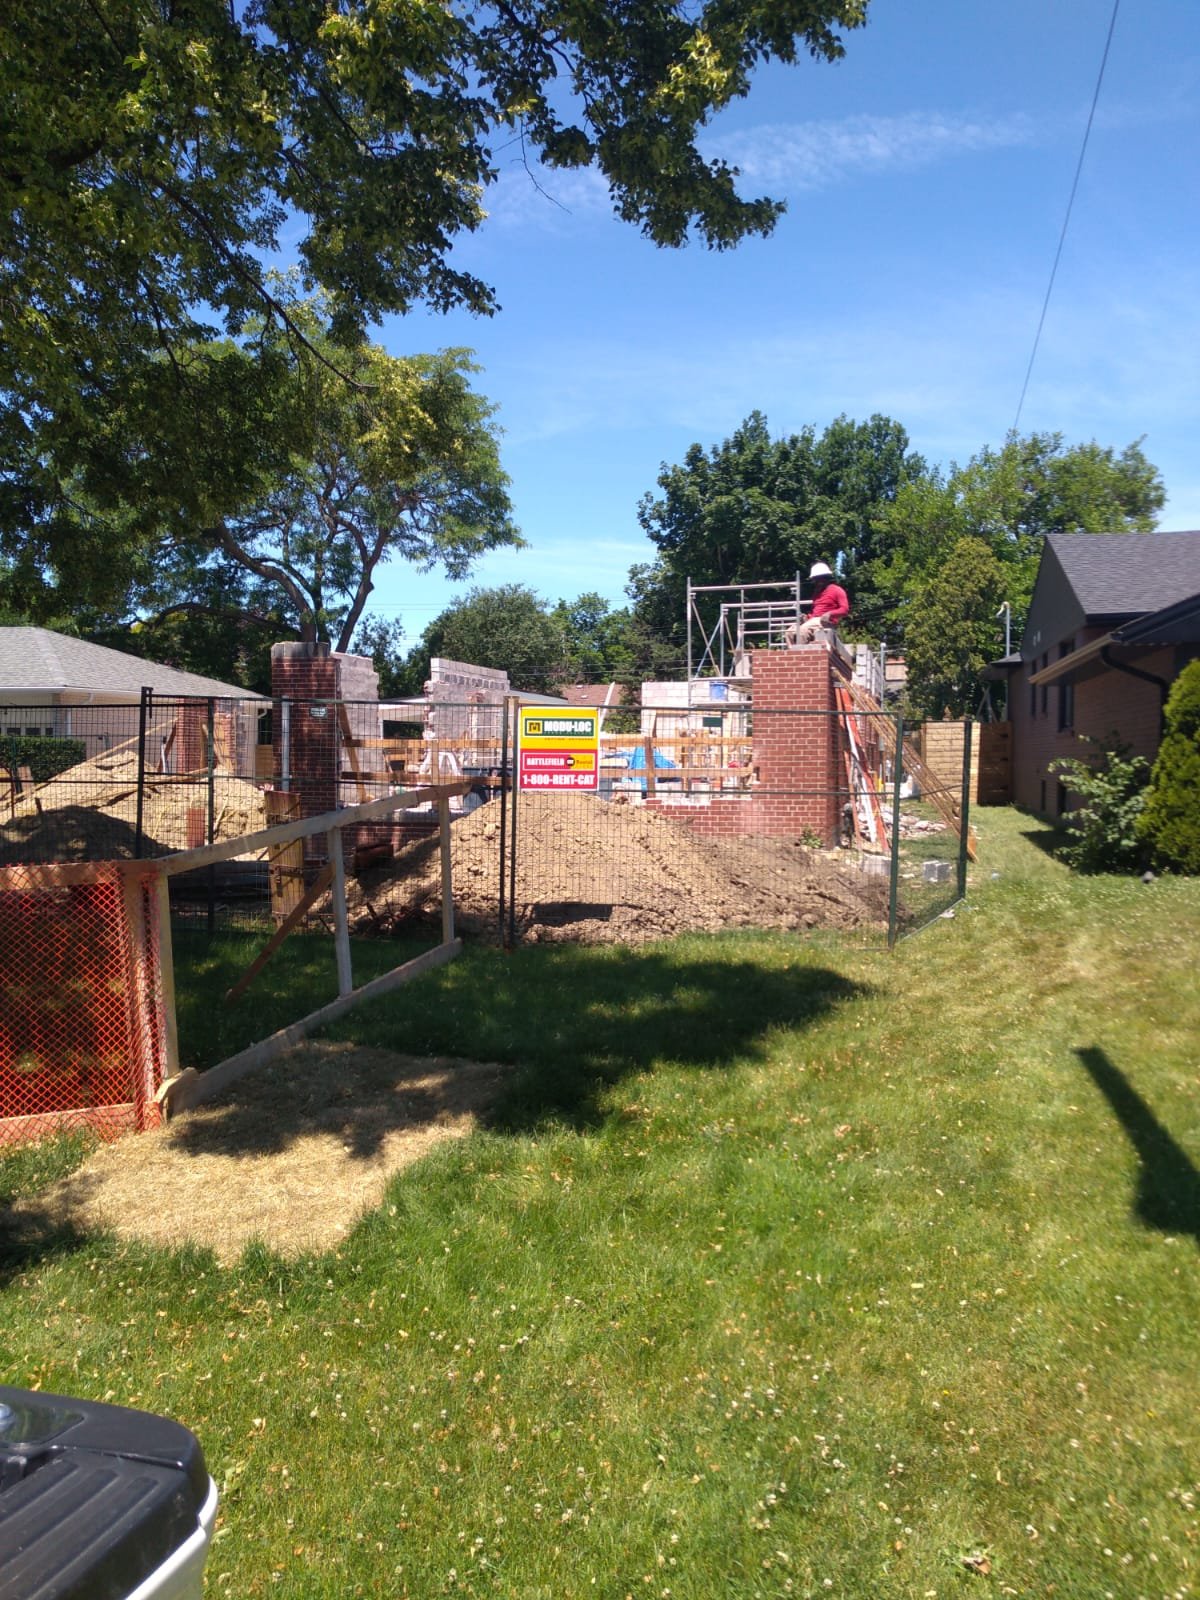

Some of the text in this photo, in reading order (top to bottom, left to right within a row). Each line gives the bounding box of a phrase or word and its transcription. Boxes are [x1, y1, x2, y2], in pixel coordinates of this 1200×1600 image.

[544, 720, 592, 732] MODU-LOC
[526, 757, 565, 766] BATTLEFIELD
[522, 774, 595, 785] 1-800-RENT-CAT
